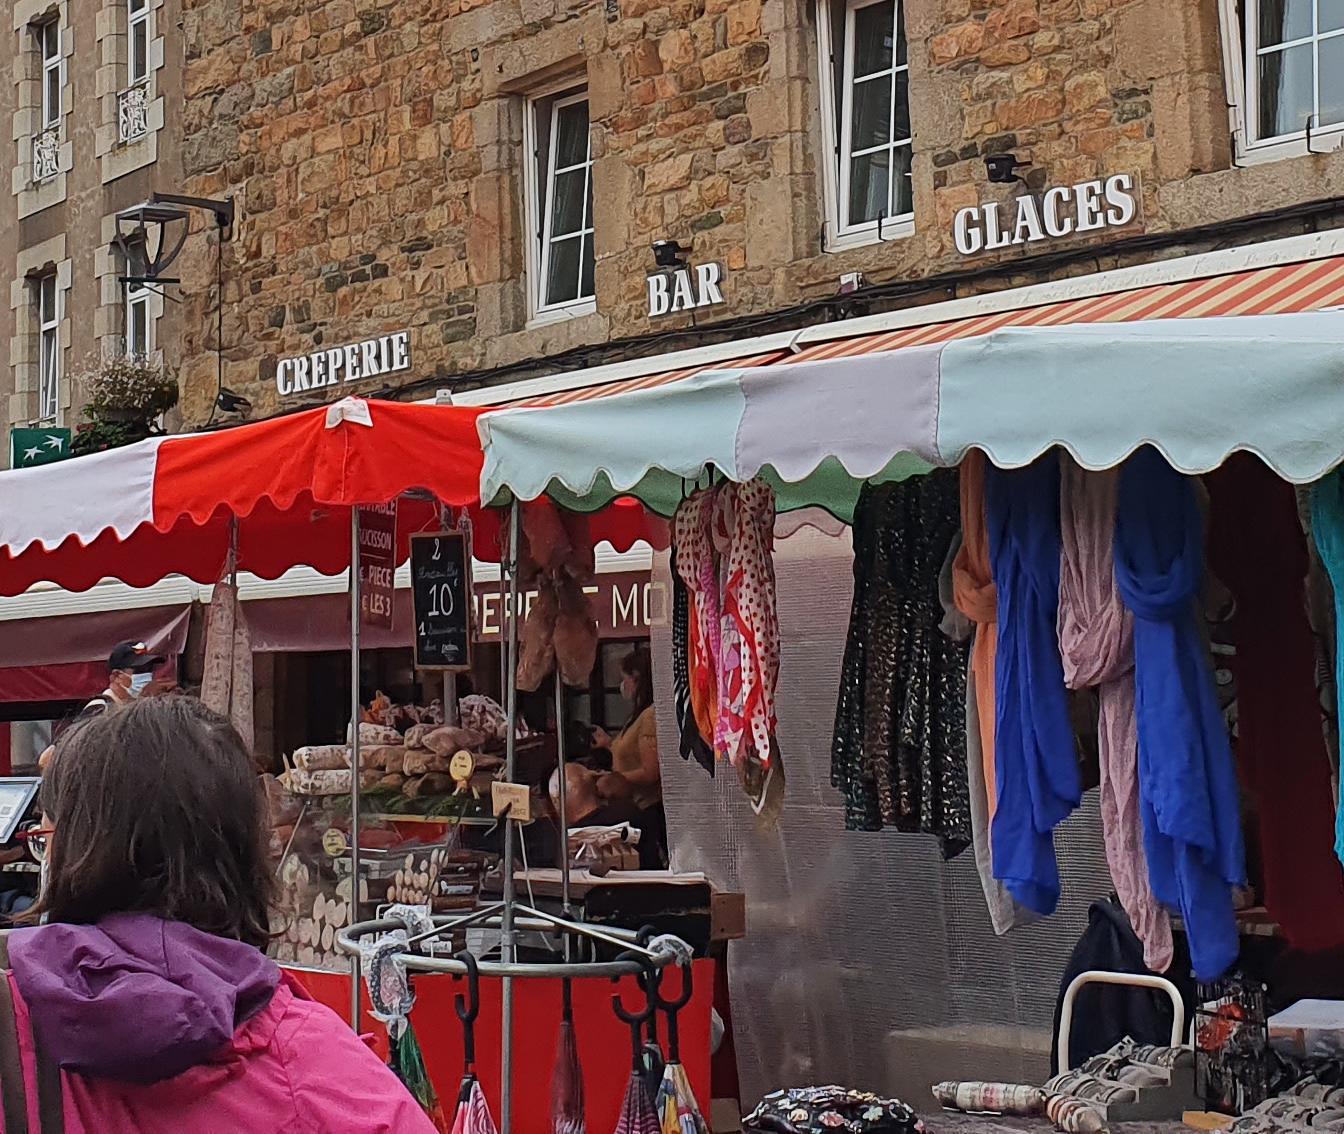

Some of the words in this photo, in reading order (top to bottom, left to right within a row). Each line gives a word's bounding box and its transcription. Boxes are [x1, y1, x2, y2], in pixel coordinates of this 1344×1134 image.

[954, 173, 1136, 255] GLACES
[646, 262, 724, 317] BAR
[275, 331, 410, 396] CREPERIE
[431, 537, 441, 560] 2
[370, 592, 384, 614] LES
